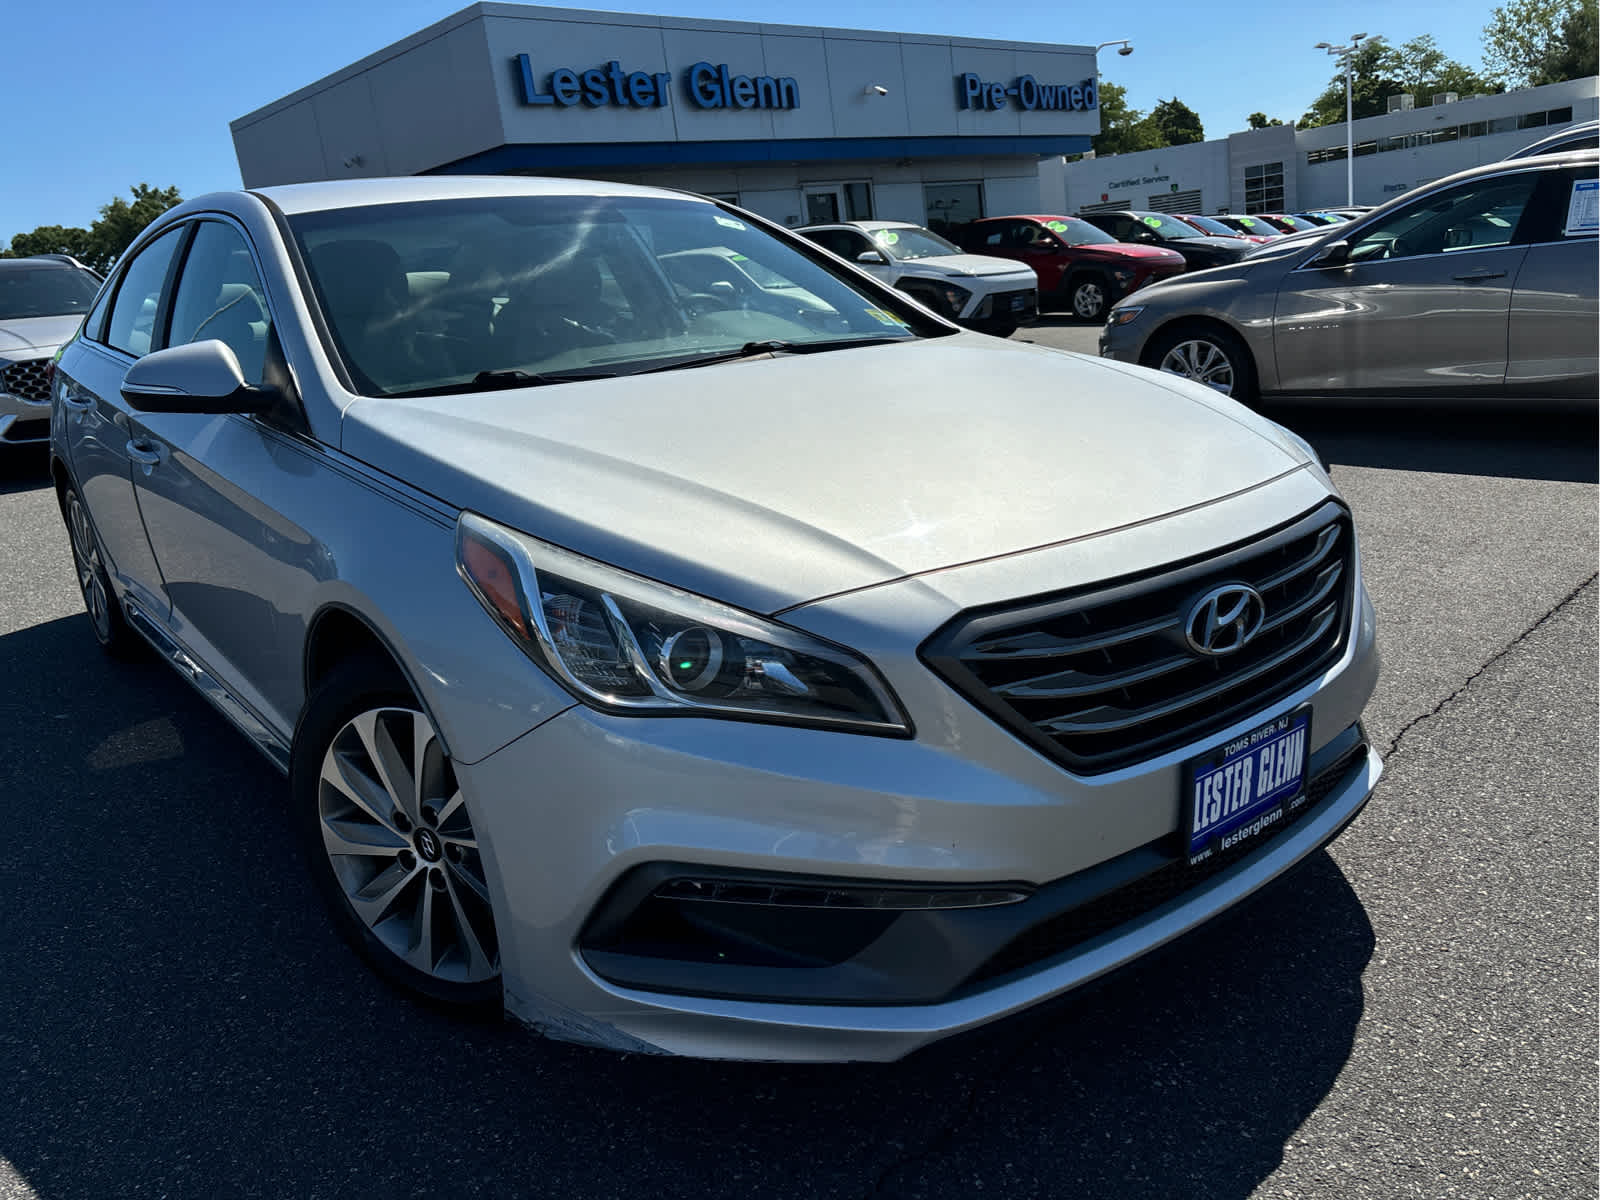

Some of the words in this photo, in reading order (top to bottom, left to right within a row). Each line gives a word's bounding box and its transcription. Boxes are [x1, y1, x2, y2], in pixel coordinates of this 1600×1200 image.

[516, 53, 671, 107] Lester
[686, 61, 800, 109] Glenn
[960, 72, 1097, 110] Pre-Owned
[1224, 738, 1249, 757] TOMS
[1278, 717, 1289, 730] NJ
[1193, 756, 1253, 833] LESTER
[1257, 728, 1305, 798] GLENN
[1221, 808, 1283, 850] lesterglenn
